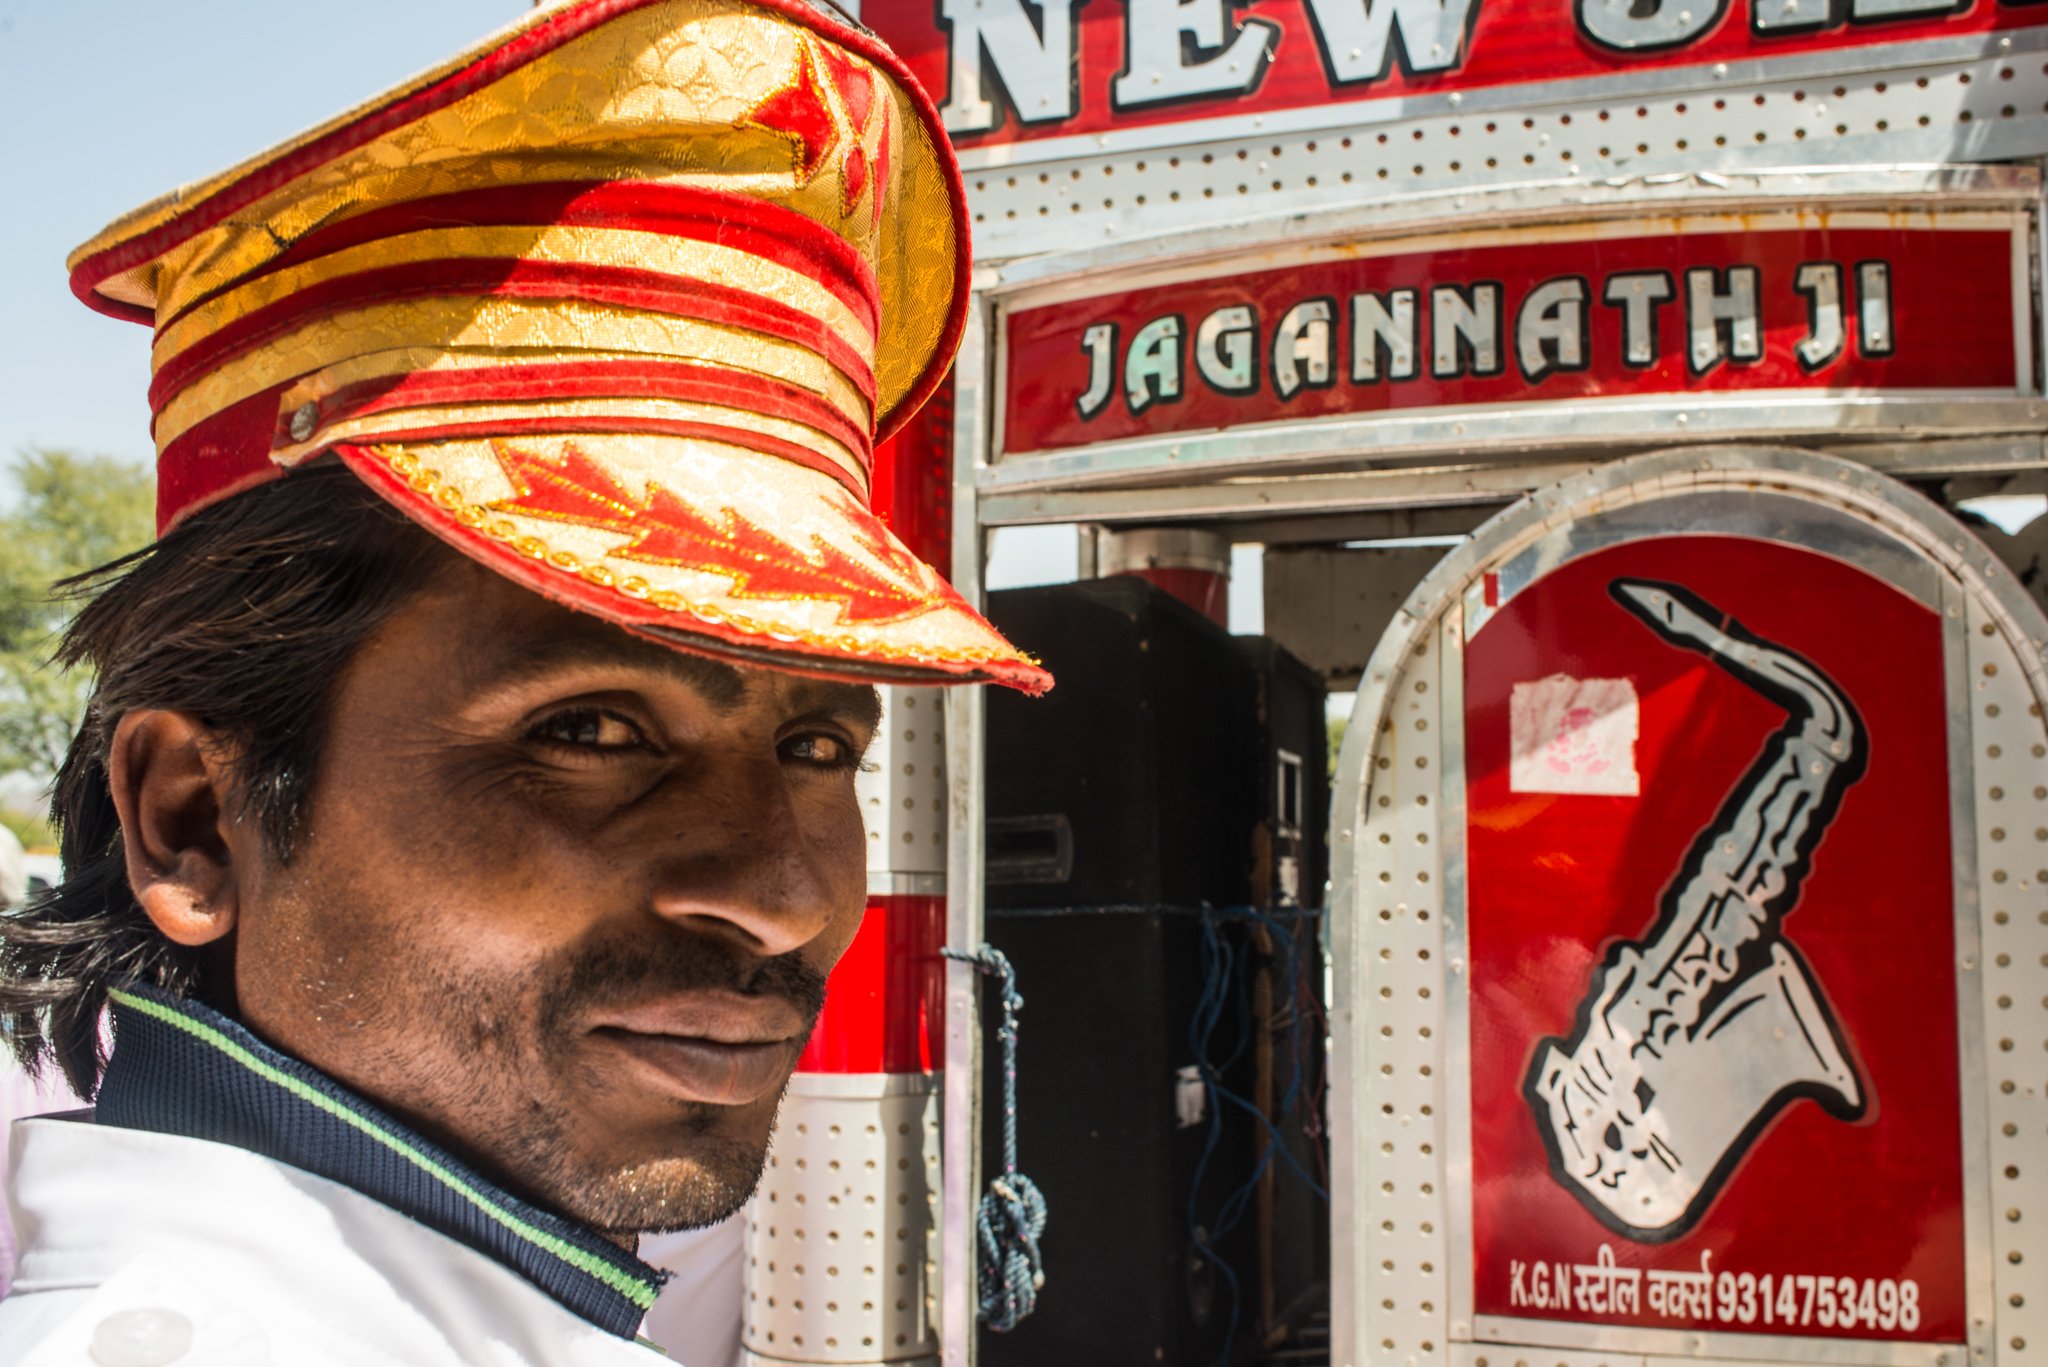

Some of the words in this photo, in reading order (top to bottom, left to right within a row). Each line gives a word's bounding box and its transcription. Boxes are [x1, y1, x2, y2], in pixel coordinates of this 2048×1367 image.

[938, 0, 1479, 128] NEW
[1077, 263, 1763, 418] JAGANNATH
[1796, 260, 1894, 374] JI
[1572, 1242, 1642, 1316] स्टील
[1646, 1248, 1714, 1321] वर्क्स
[1716, 1270, 1921, 1332] 9314753498
